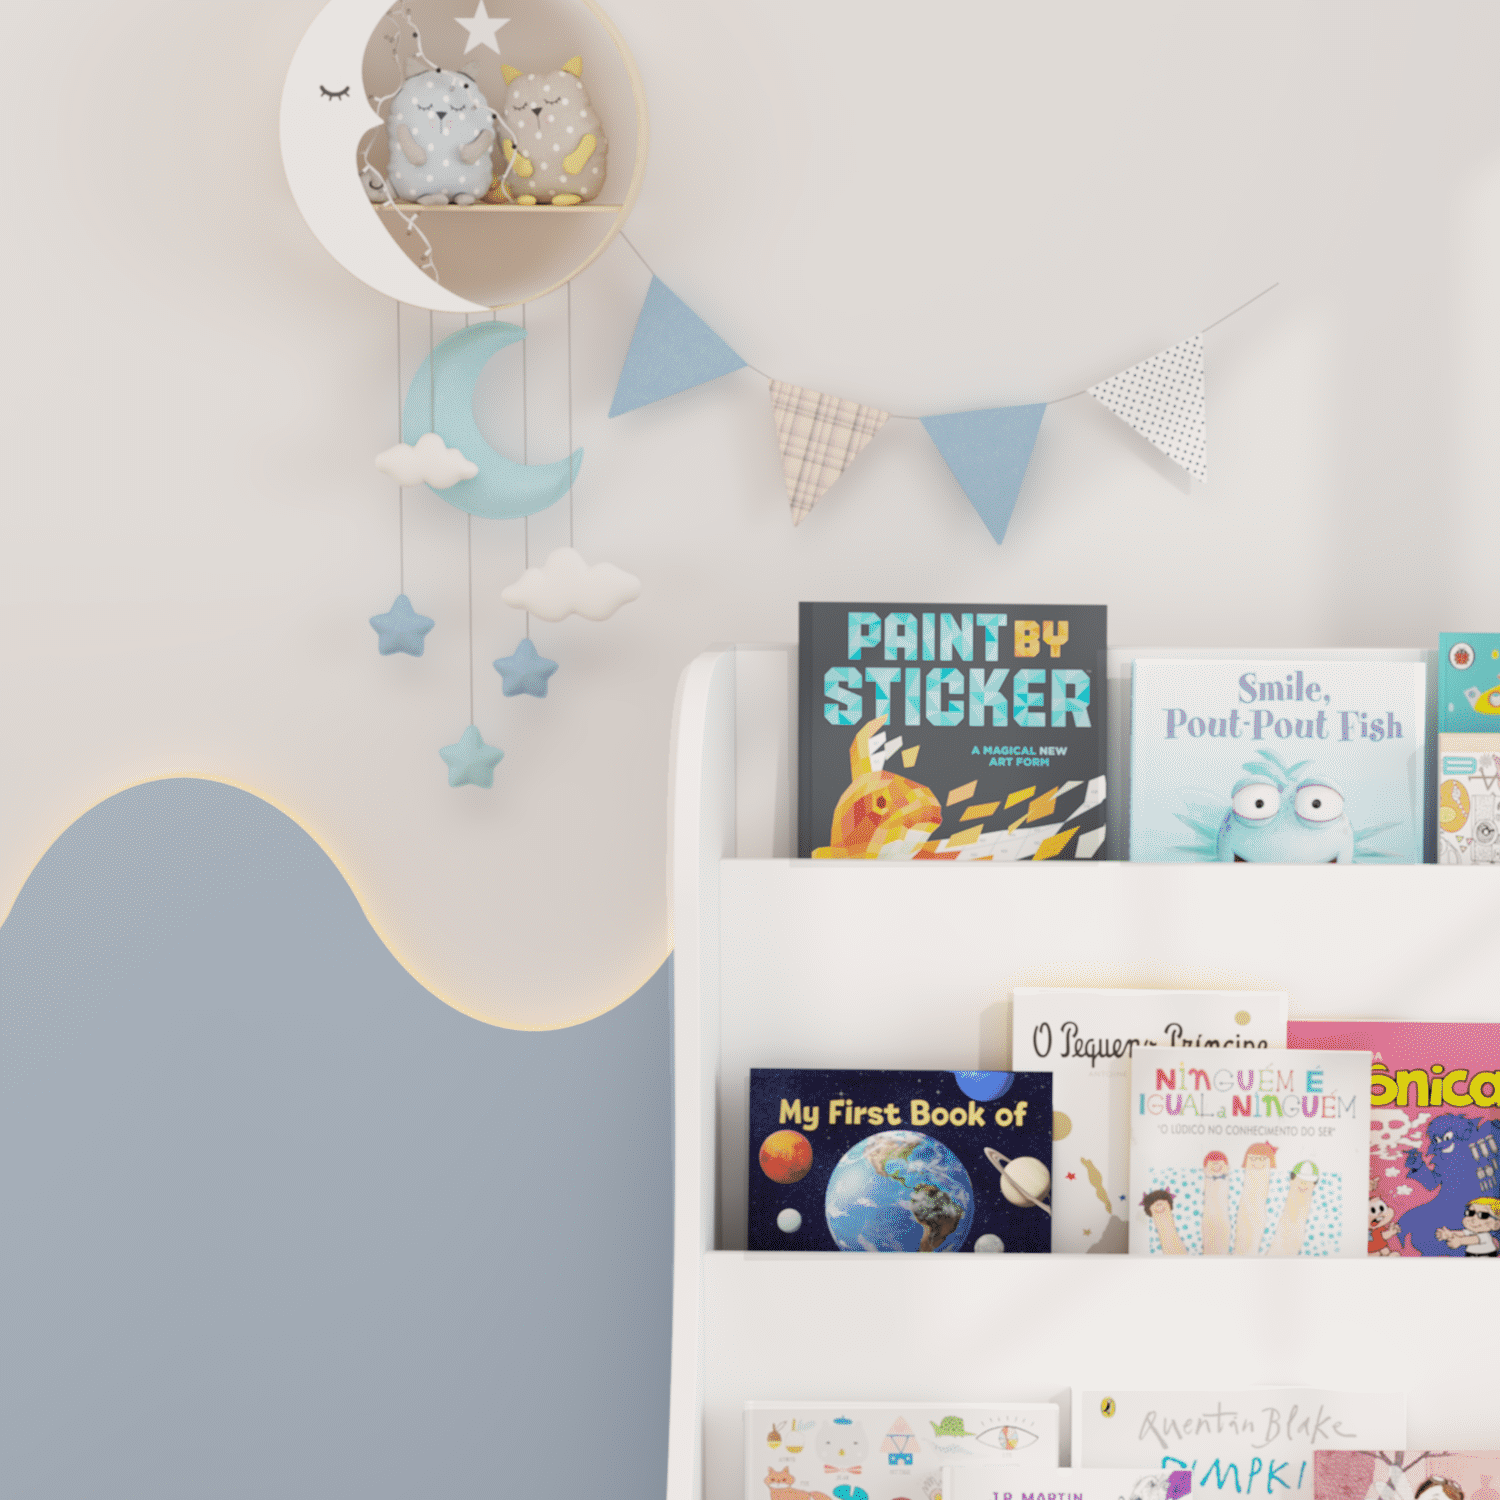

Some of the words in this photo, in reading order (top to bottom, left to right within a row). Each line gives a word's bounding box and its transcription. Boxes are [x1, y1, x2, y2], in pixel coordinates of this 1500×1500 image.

[848, 612, 1007, 661] PAINT
[1014, 620, 1069, 657] BY
[824, 667, 1091, 727] STICKER
[1238, 670, 1331, 706] Smile,
[1162, 708, 1329, 741] Pout-Pout
[1336, 710, 1404, 742] Fish
[971, 746, 980, 755] A
[983, 746, 1036, 756] MAGICAL
[1039, 747, 1068, 756] NEW
[989, 757, 1013, 766] ART
[1016, 758, 1050, 766] FORM
[1033, 1022, 1052, 1058] O
[779, 1098, 819, 1131] My
[829, 1099, 901, 1126] First
[911, 1099, 986, 1127] Book
[995, 1102, 1028, 1127] of
[1139, 1093, 1214, 1118] IGUAL
[1171, 1123, 1205, 1135] LÚDICO
[1208, 1125, 1223, 1135] NO
[1225, 1125, 1298, 1136] CONHECIMENTO
[1301, 1126, 1316, 1136] DO
[1139, 1402, 1255, 1449] Quentin
[1251, 1403, 1357, 1449] Blake
